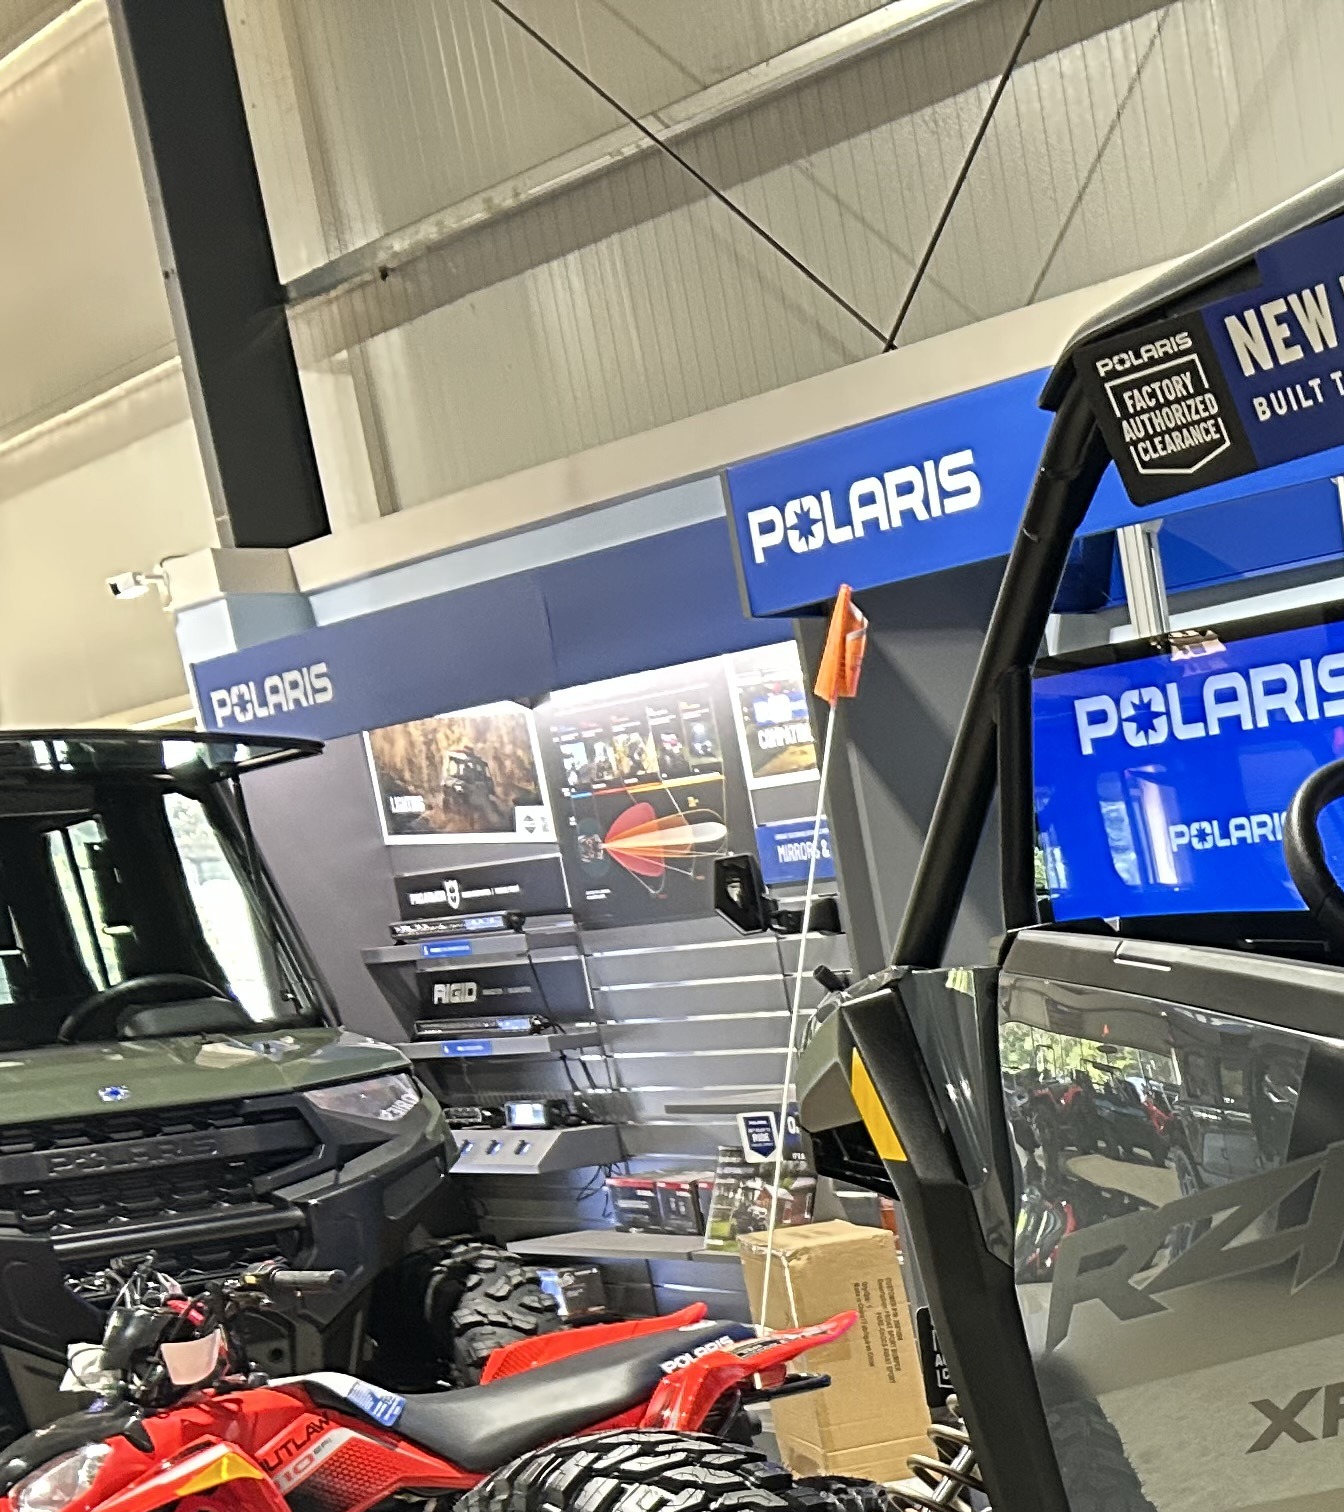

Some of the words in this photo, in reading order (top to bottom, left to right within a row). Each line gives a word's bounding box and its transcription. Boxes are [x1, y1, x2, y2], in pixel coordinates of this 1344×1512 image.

[1224, 284, 1338, 377] NEW
[1095, 331, 1193, 377] POLARIS
[1122, 371, 1195, 414] FACTORY
[1253, 377, 1325, 422] BUILT
[1121, 392, 1219, 443] AUTHORIZED
[1137, 418, 1221, 463] CLEARANCE
[747, 448, 982, 564] POLARIS
[210, 661, 334, 729] POLARIS
[1170, 813, 1288, 852] POLARI
[661, 1335, 736, 1375] POLARIS
[262, 1411, 332, 1471] UTLAW
[274, 1455, 315, 1490] 10
